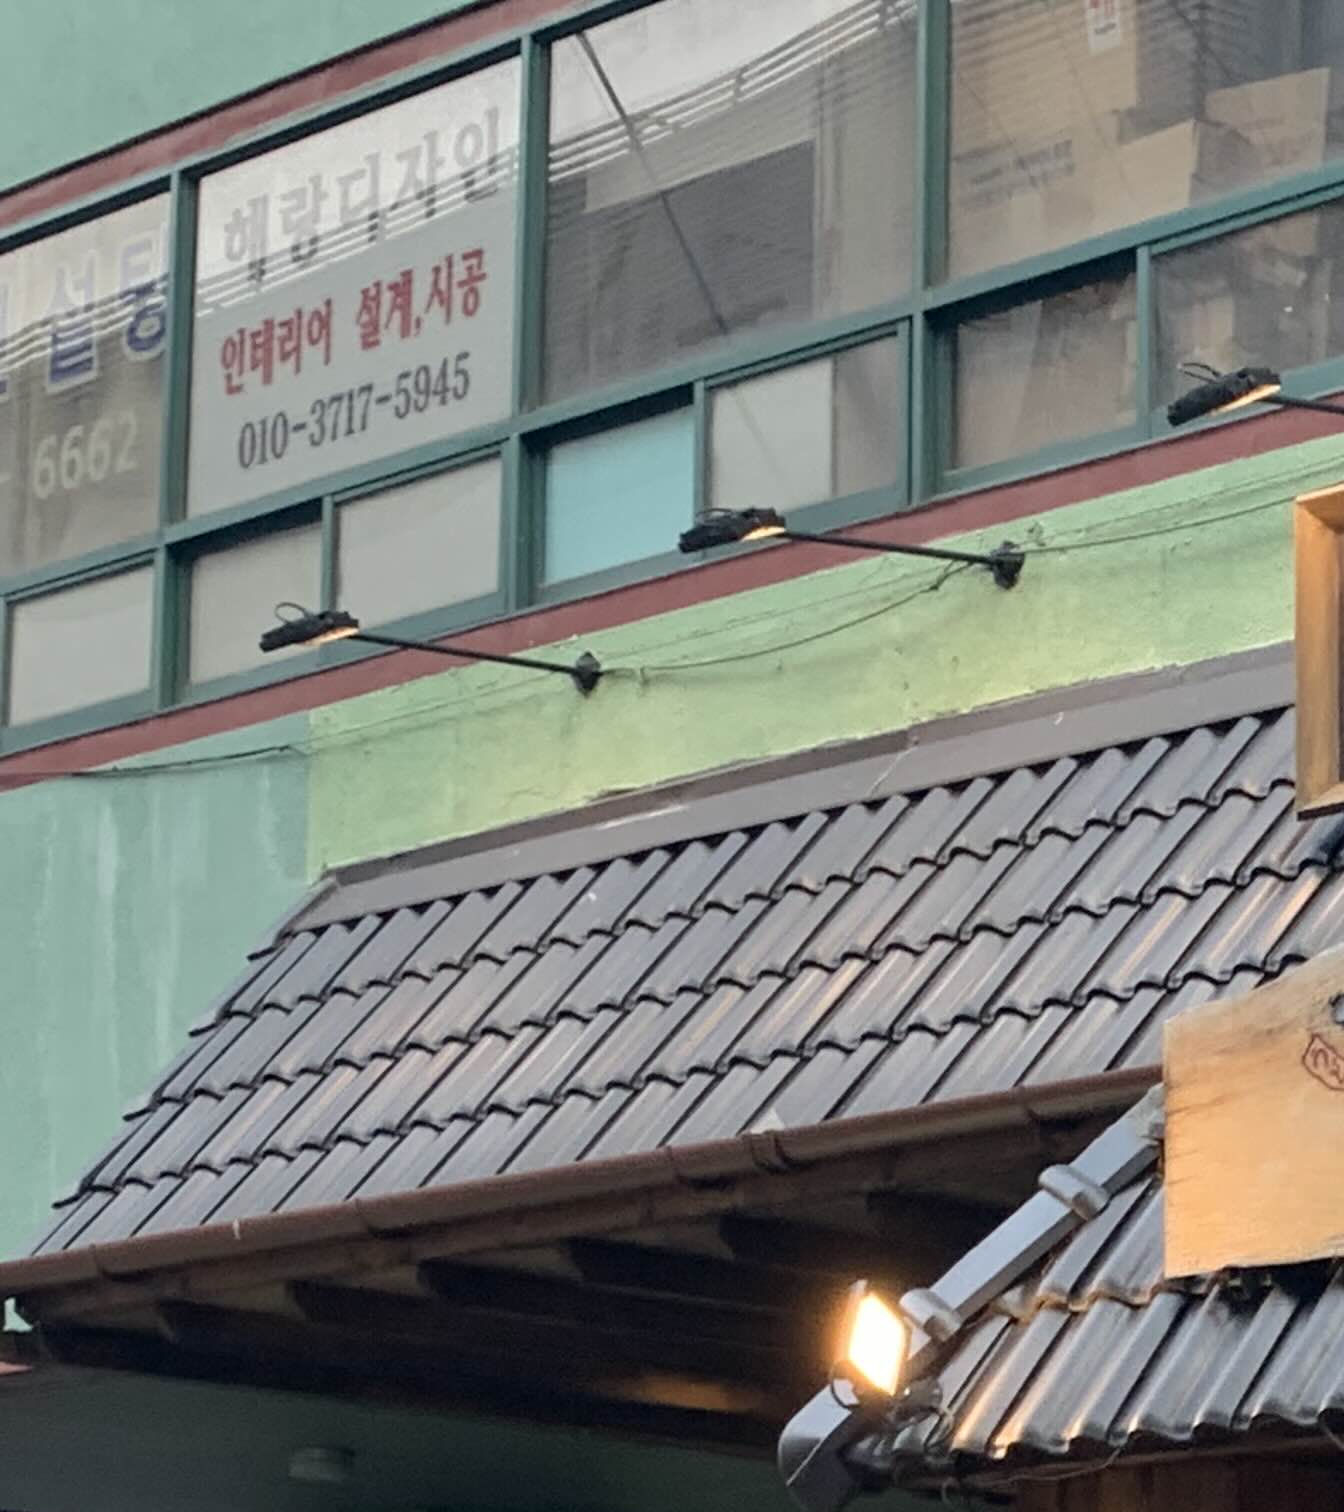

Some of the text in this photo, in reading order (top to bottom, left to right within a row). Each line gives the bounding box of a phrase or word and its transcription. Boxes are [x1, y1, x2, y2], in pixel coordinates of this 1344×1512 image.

[220, 248, 487, 396] 인테리어 설계,시공
[237, 351, 471, 470] 010-3717-5945
